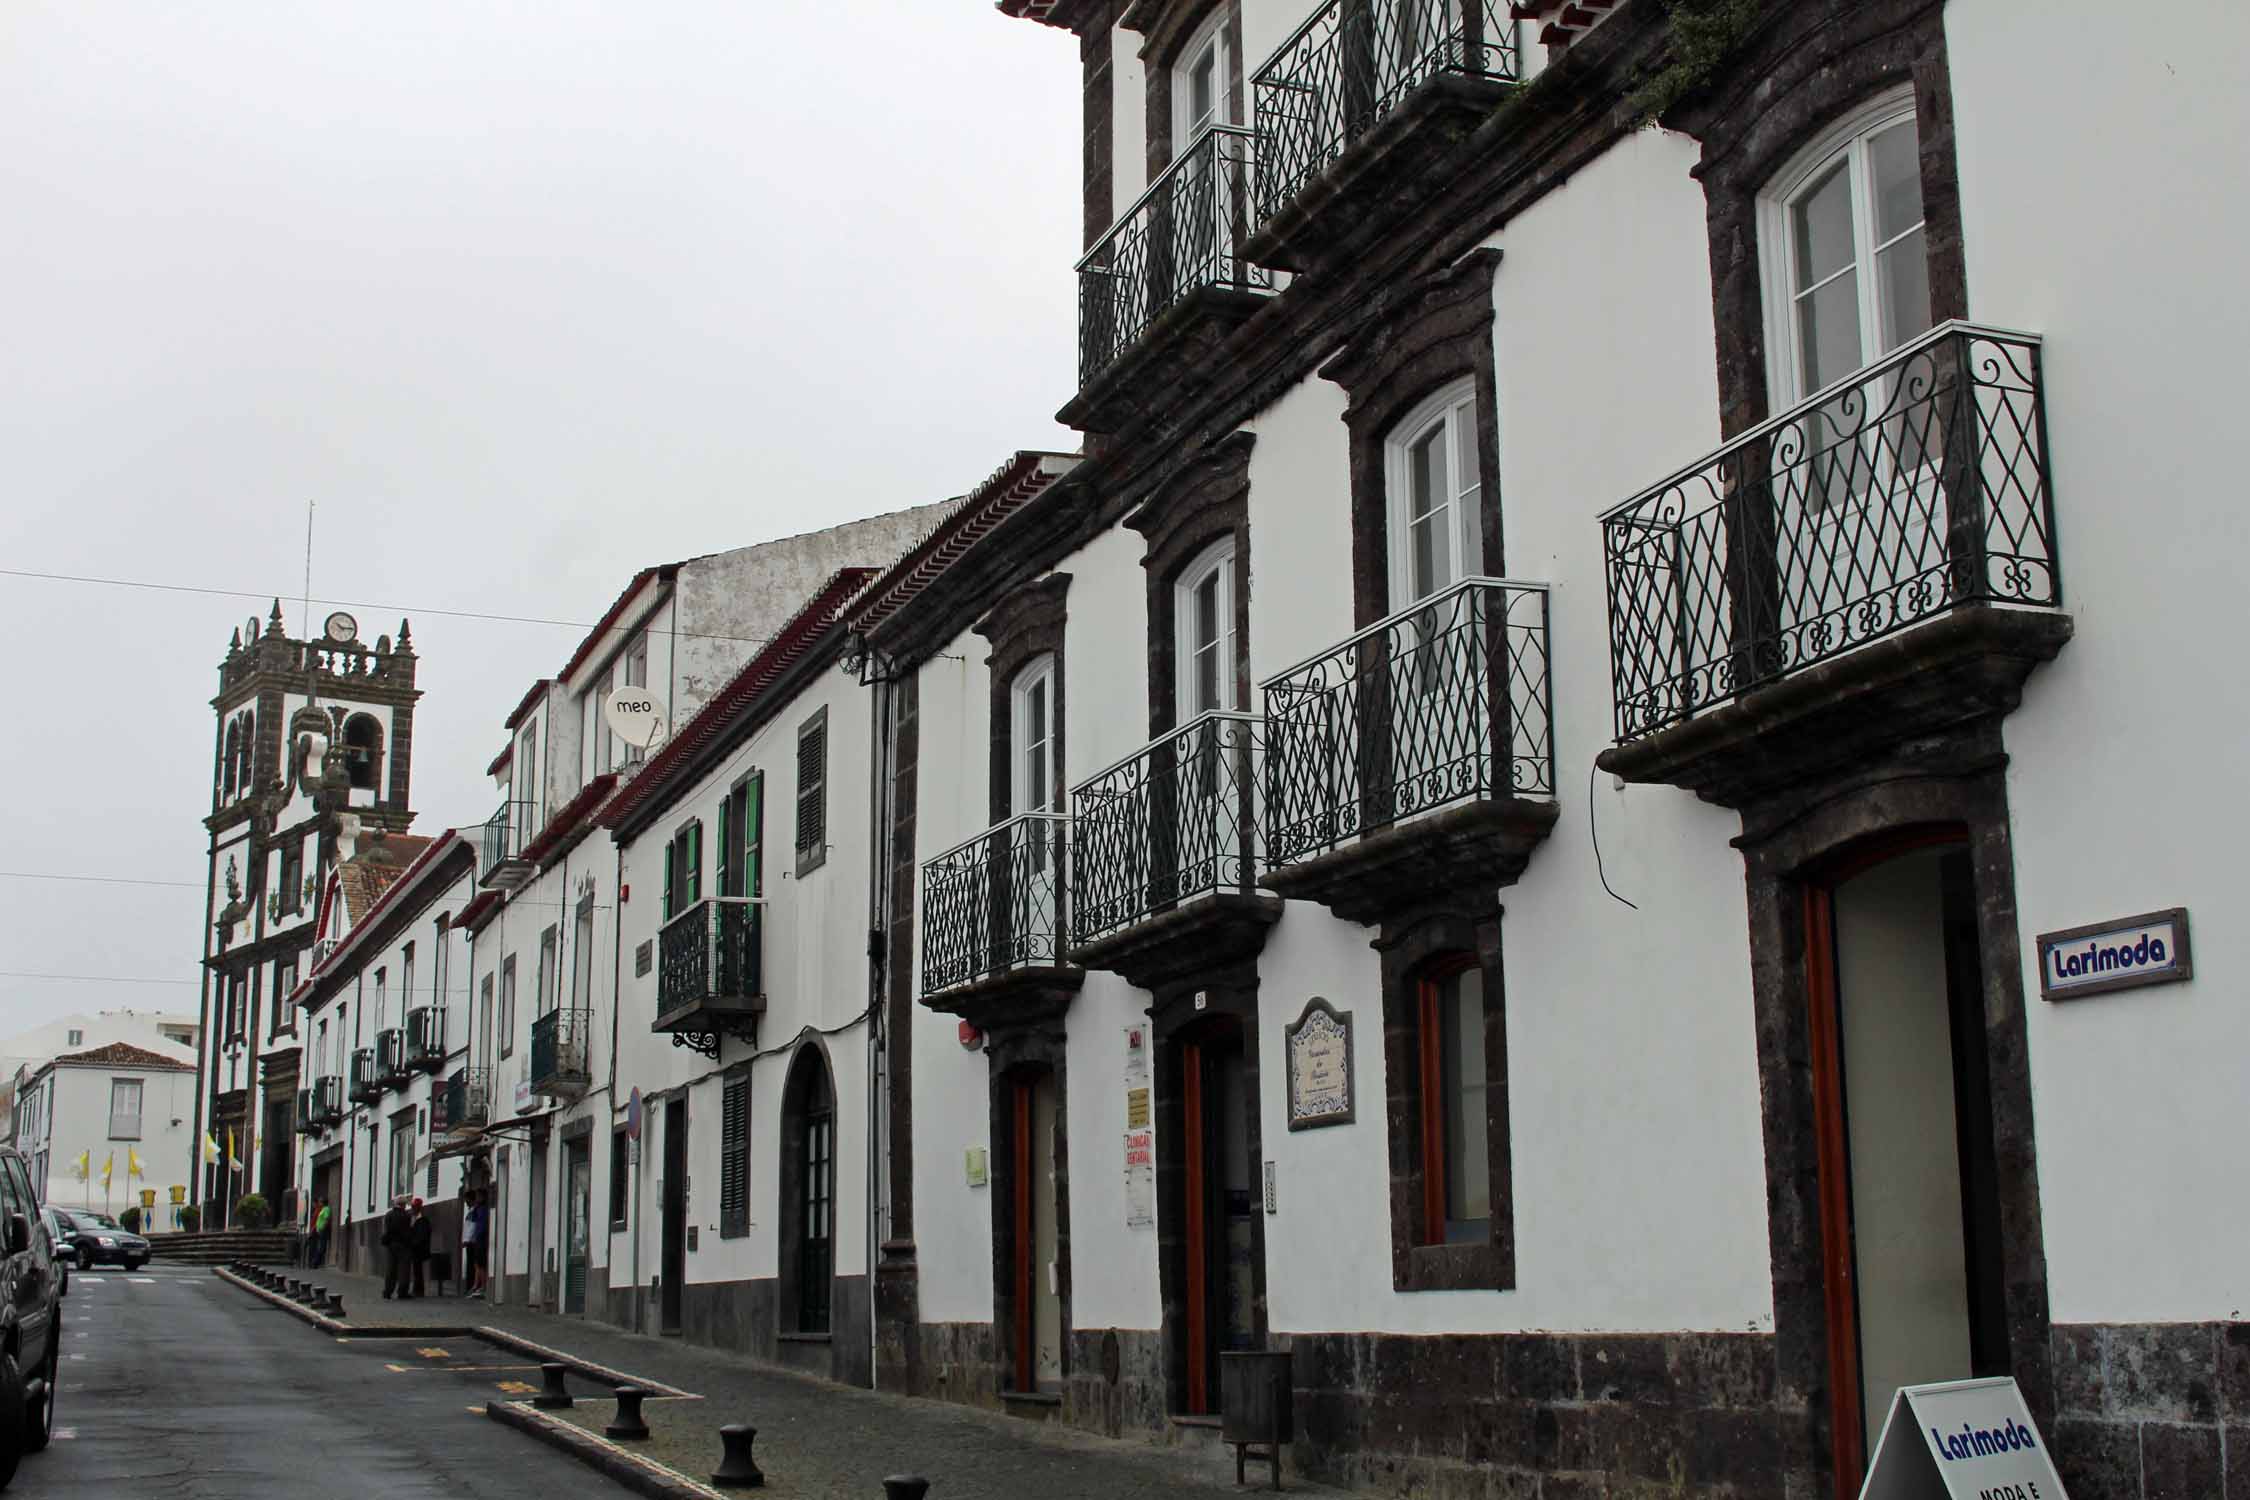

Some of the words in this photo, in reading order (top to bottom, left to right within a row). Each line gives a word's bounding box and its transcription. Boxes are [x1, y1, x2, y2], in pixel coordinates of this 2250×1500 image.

[616, 701, 652, 713] meo
[2054, 933, 2166, 978] Larimoda
[1930, 1417, 2036, 1461] Larimoda
[2027, 1482, 2040, 1499] E
